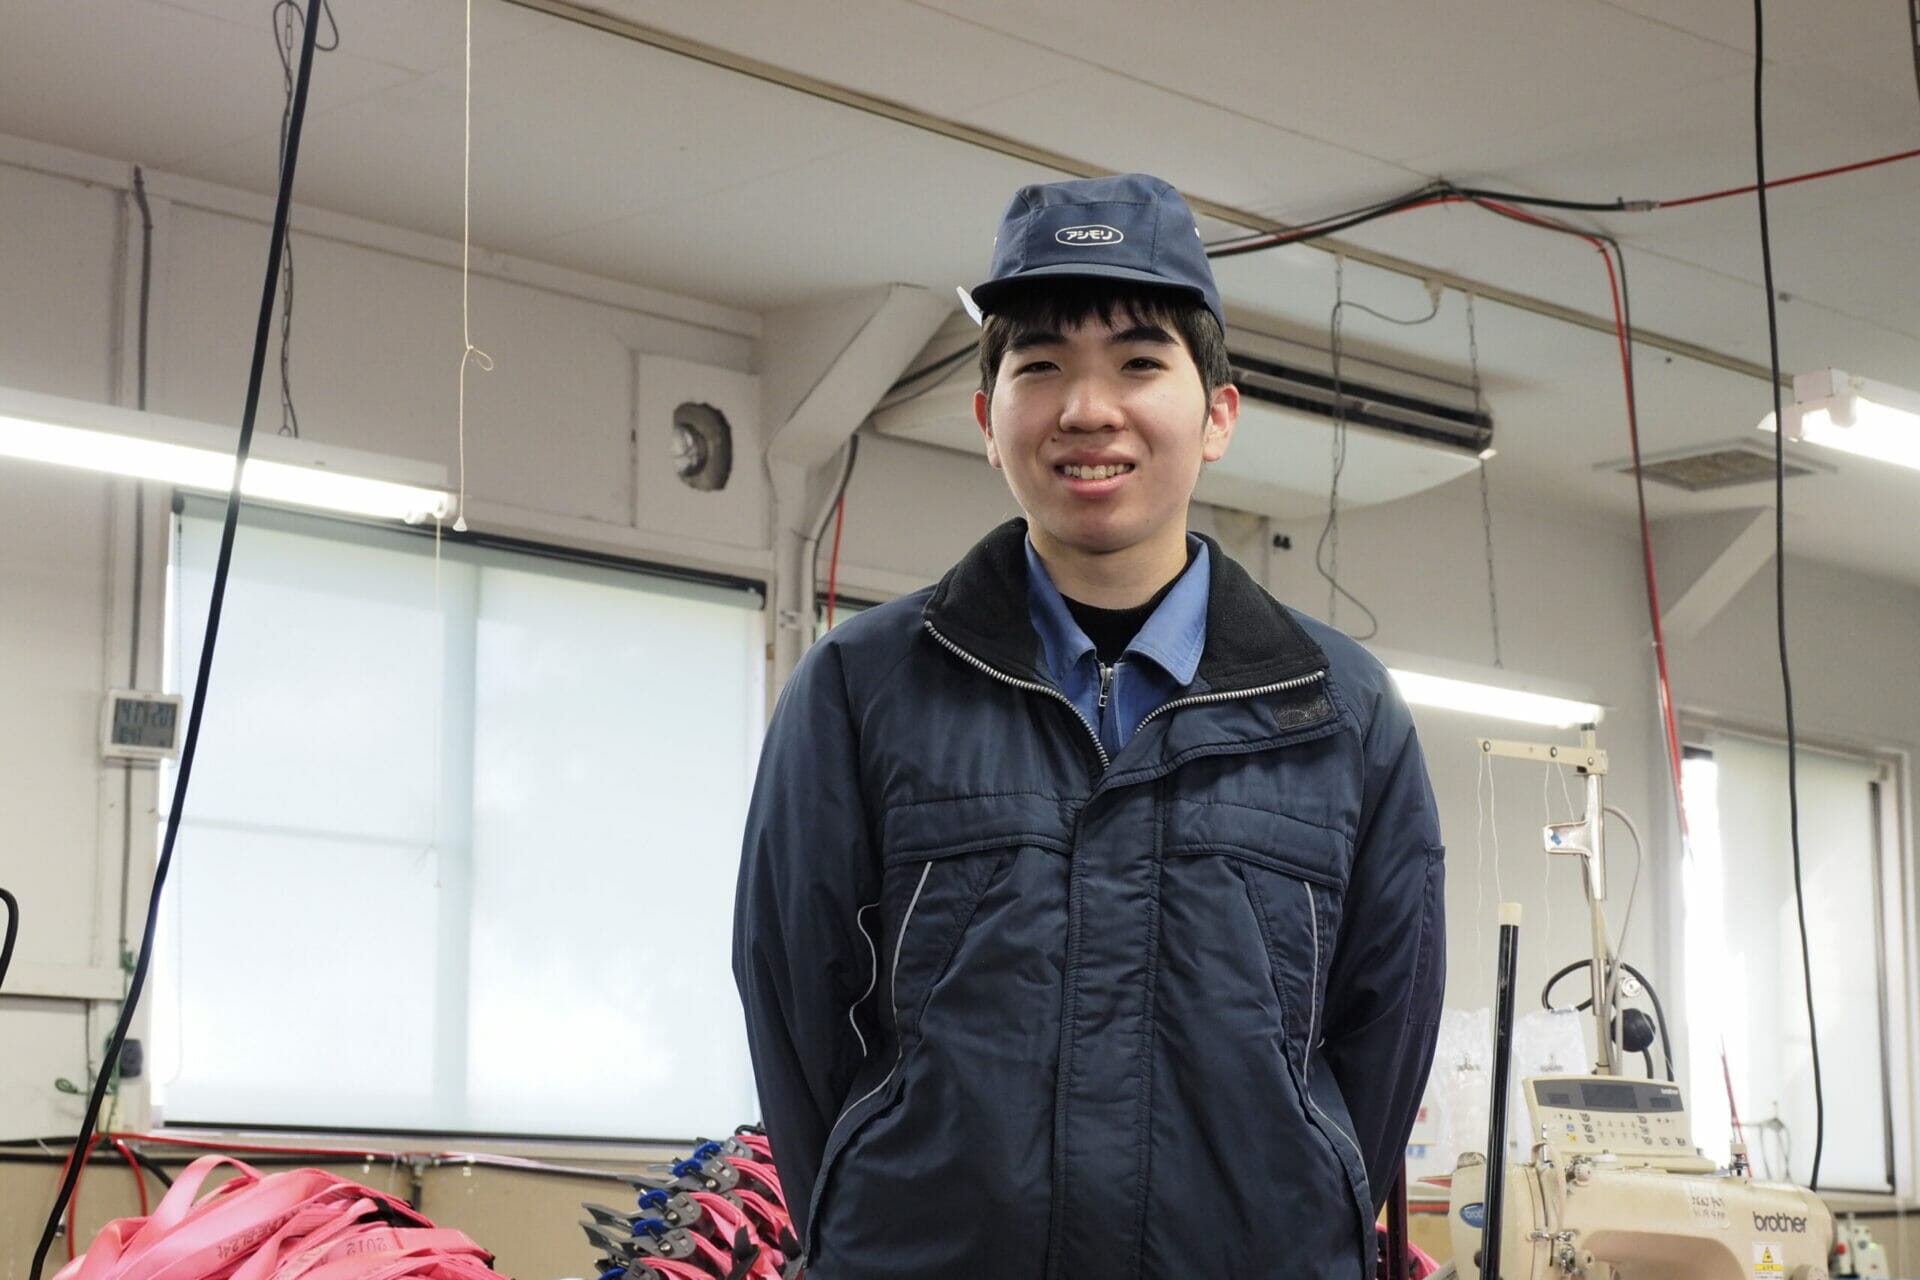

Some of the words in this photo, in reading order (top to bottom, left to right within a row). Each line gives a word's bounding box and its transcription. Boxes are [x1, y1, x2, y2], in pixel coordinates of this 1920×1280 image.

[1066, 230, 1113, 240] アシモリ
[1752, 1210, 1807, 1233] brother
[346, 1237, 388, 1256] 2012
